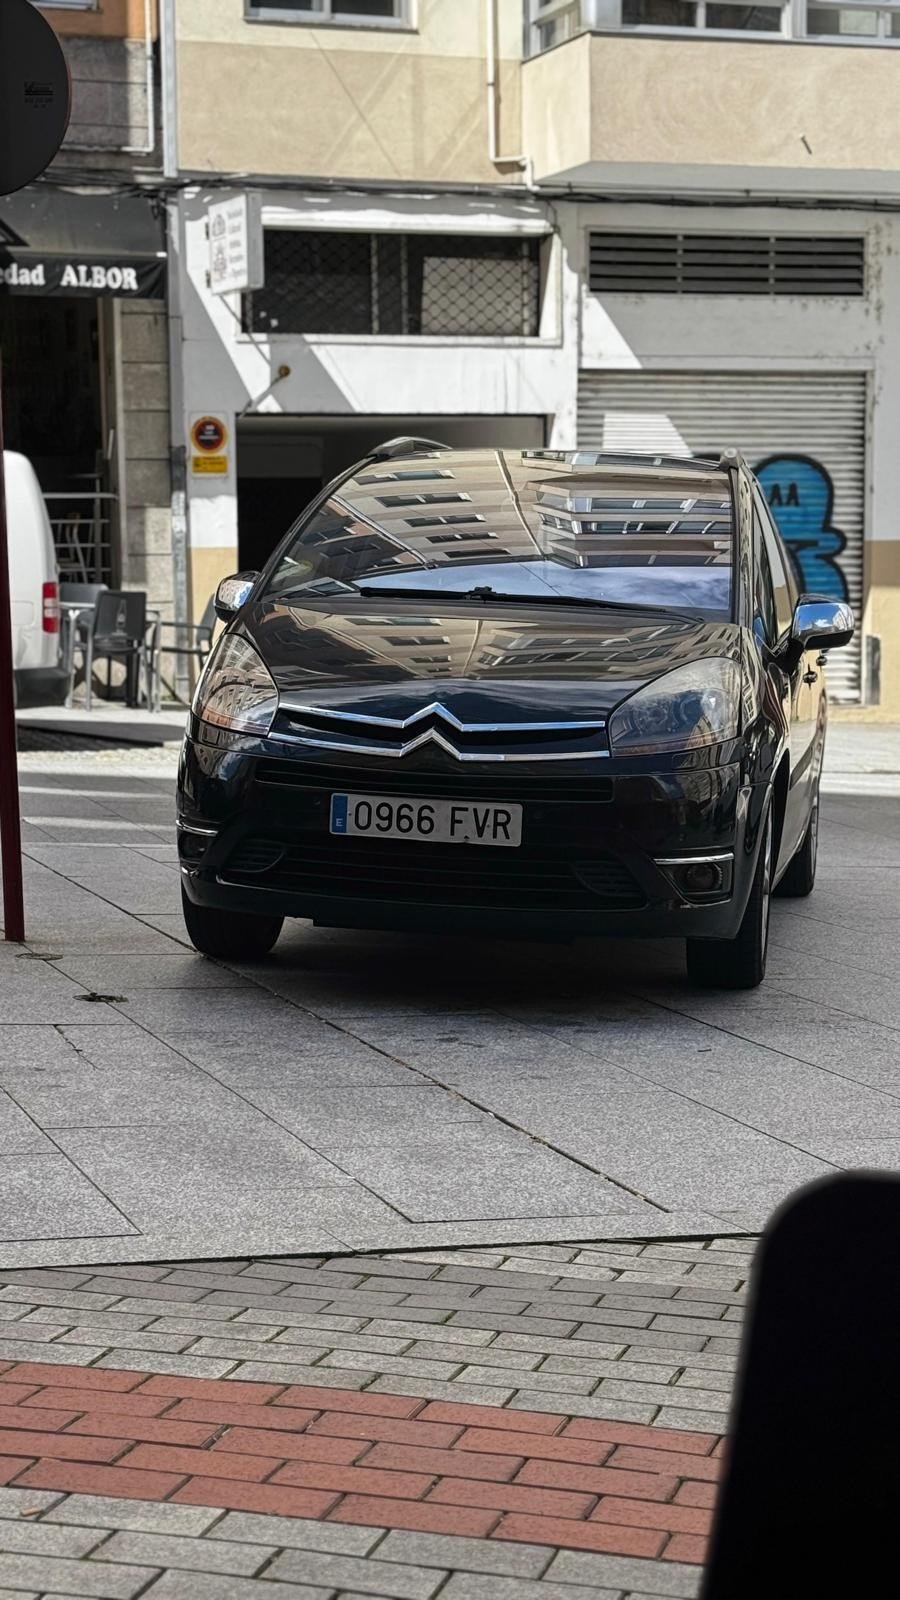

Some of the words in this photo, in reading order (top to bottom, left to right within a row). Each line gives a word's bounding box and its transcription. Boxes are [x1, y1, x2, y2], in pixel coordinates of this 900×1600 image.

[60, 264, 138, 290] ALBOR
[335, 818, 343, 826] E
[354, 800, 435, 835] 0966
[449, 806, 512, 840] FVR
